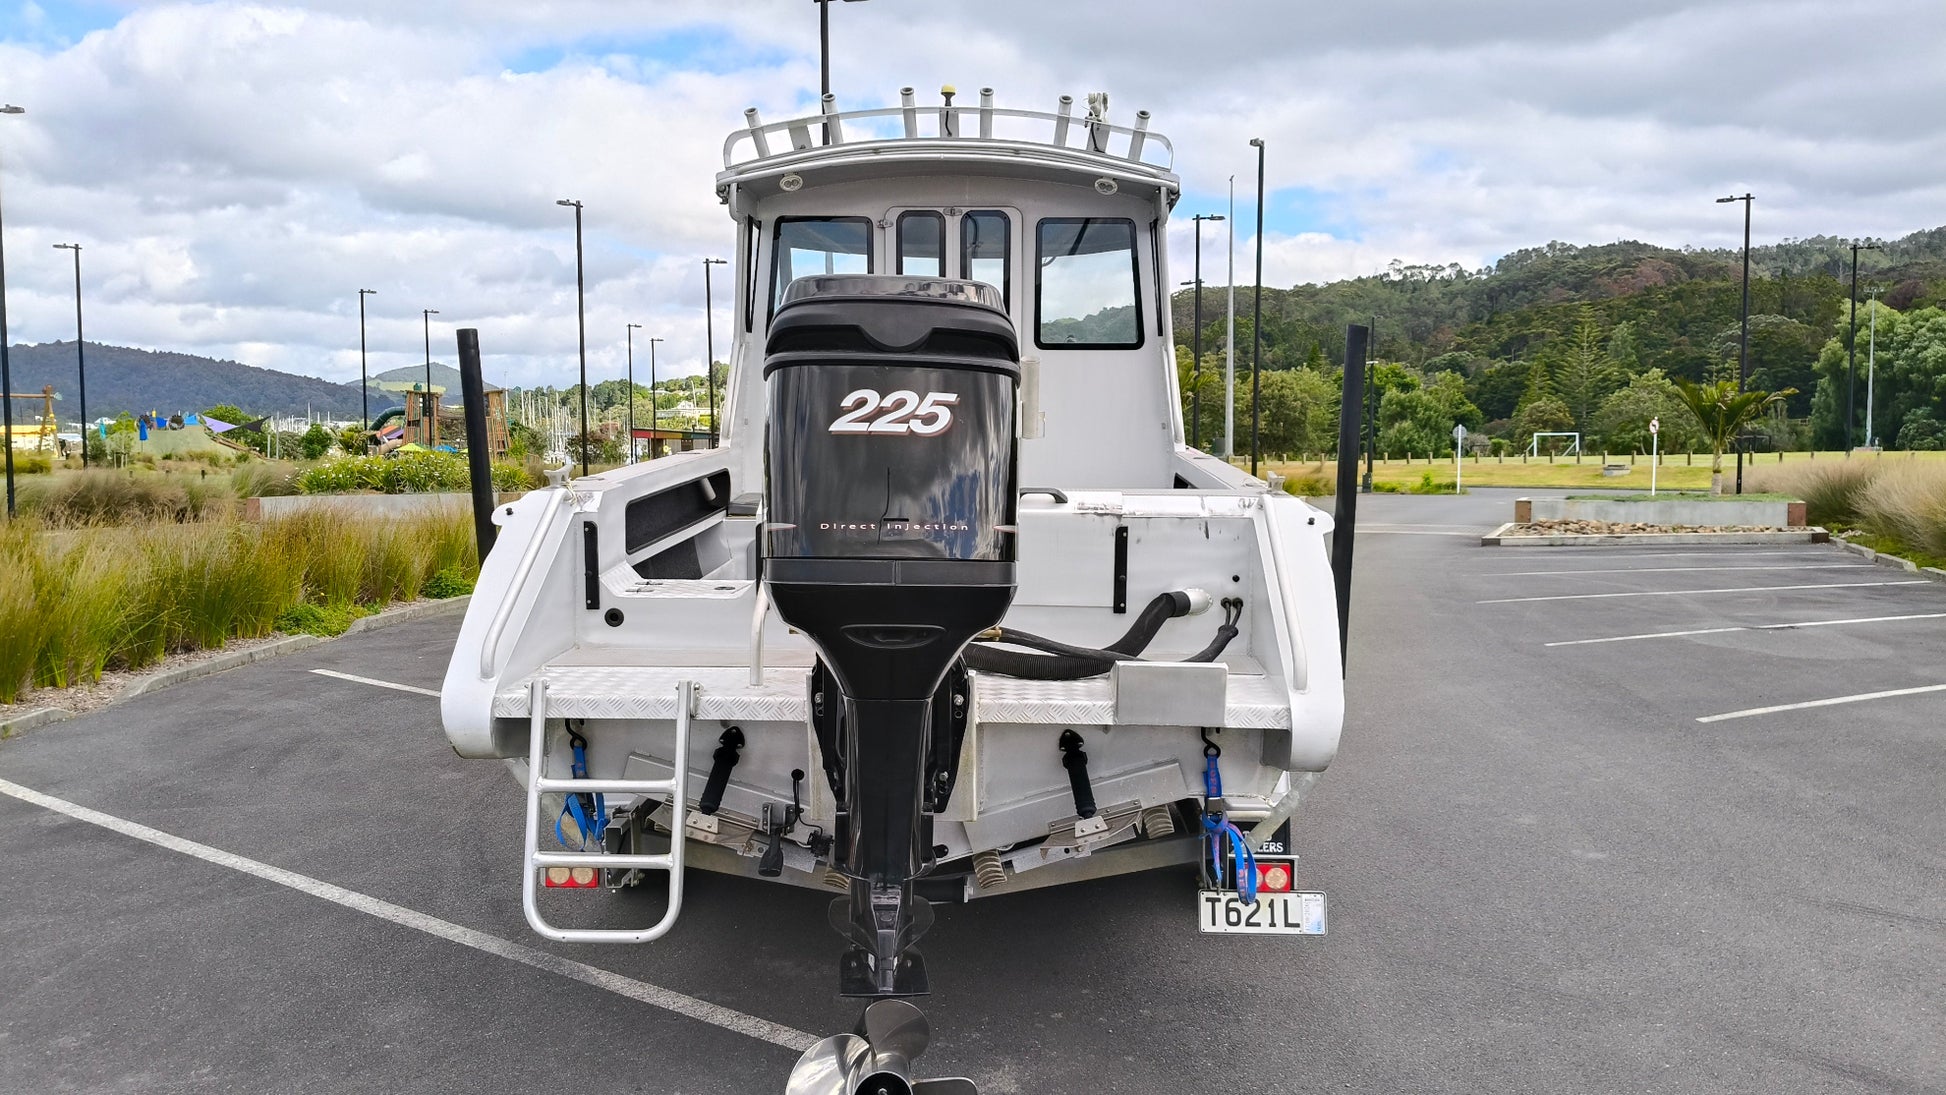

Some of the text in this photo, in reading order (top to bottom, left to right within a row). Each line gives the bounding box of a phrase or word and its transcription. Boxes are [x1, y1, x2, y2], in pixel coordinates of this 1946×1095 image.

[828, 388, 959, 437] 225
[887, 523, 969, 531] Injection
[1205, 897, 1301, 928] T621L
